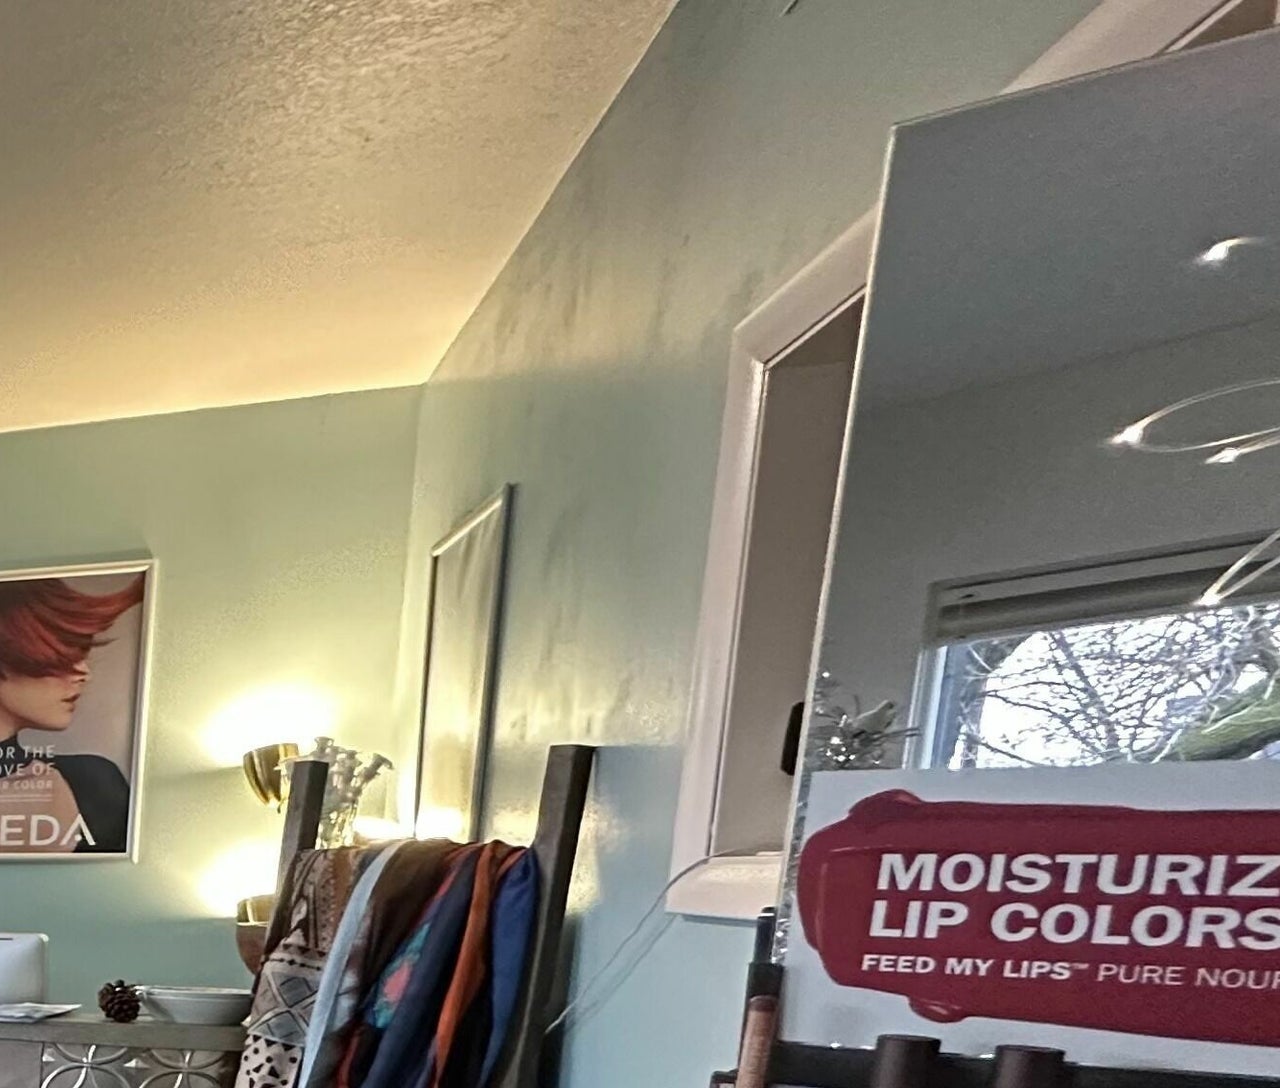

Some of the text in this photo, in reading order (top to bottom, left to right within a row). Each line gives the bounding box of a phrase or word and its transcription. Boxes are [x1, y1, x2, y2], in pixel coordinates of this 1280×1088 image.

[23, 744, 56, 759] THE
[31, 761, 56, 777] OF
[13, 779, 53, 790] COLOR
[876, 853, 1280, 897] MOISTURIZ
[868, 899, 1280, 951] LIP COLORS
[860, 953, 937, 974] FEED
[944, 957, 995, 977] MY
[1096, 963, 1187, 986] PURE
